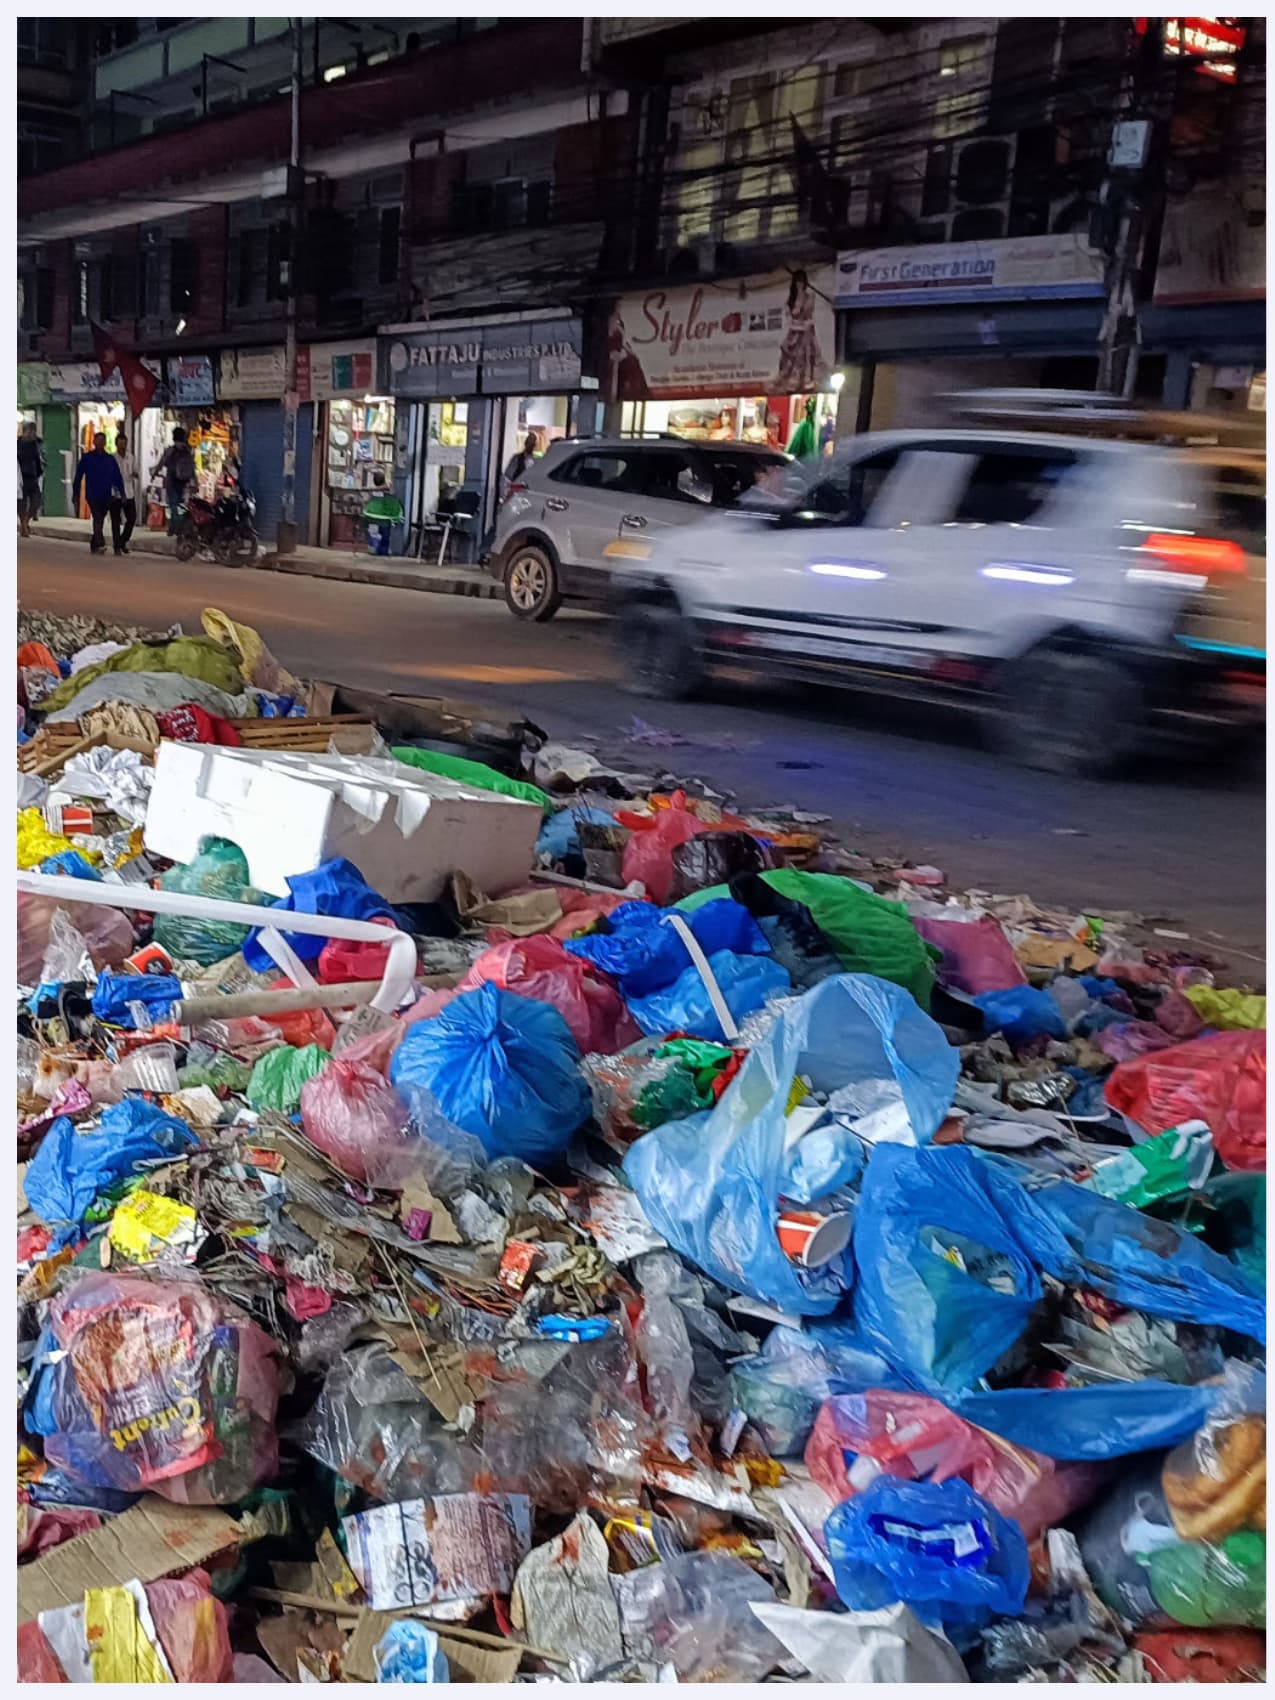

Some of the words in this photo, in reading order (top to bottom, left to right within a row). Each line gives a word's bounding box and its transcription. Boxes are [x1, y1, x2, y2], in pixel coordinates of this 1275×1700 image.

[859, 264, 898, 280] First
[899, 259, 995, 278] Generation
[632, 287, 720, 356] Styler
[409, 343, 481, 366] FATTAJU
[109, 1397, 201, 1452] Current
